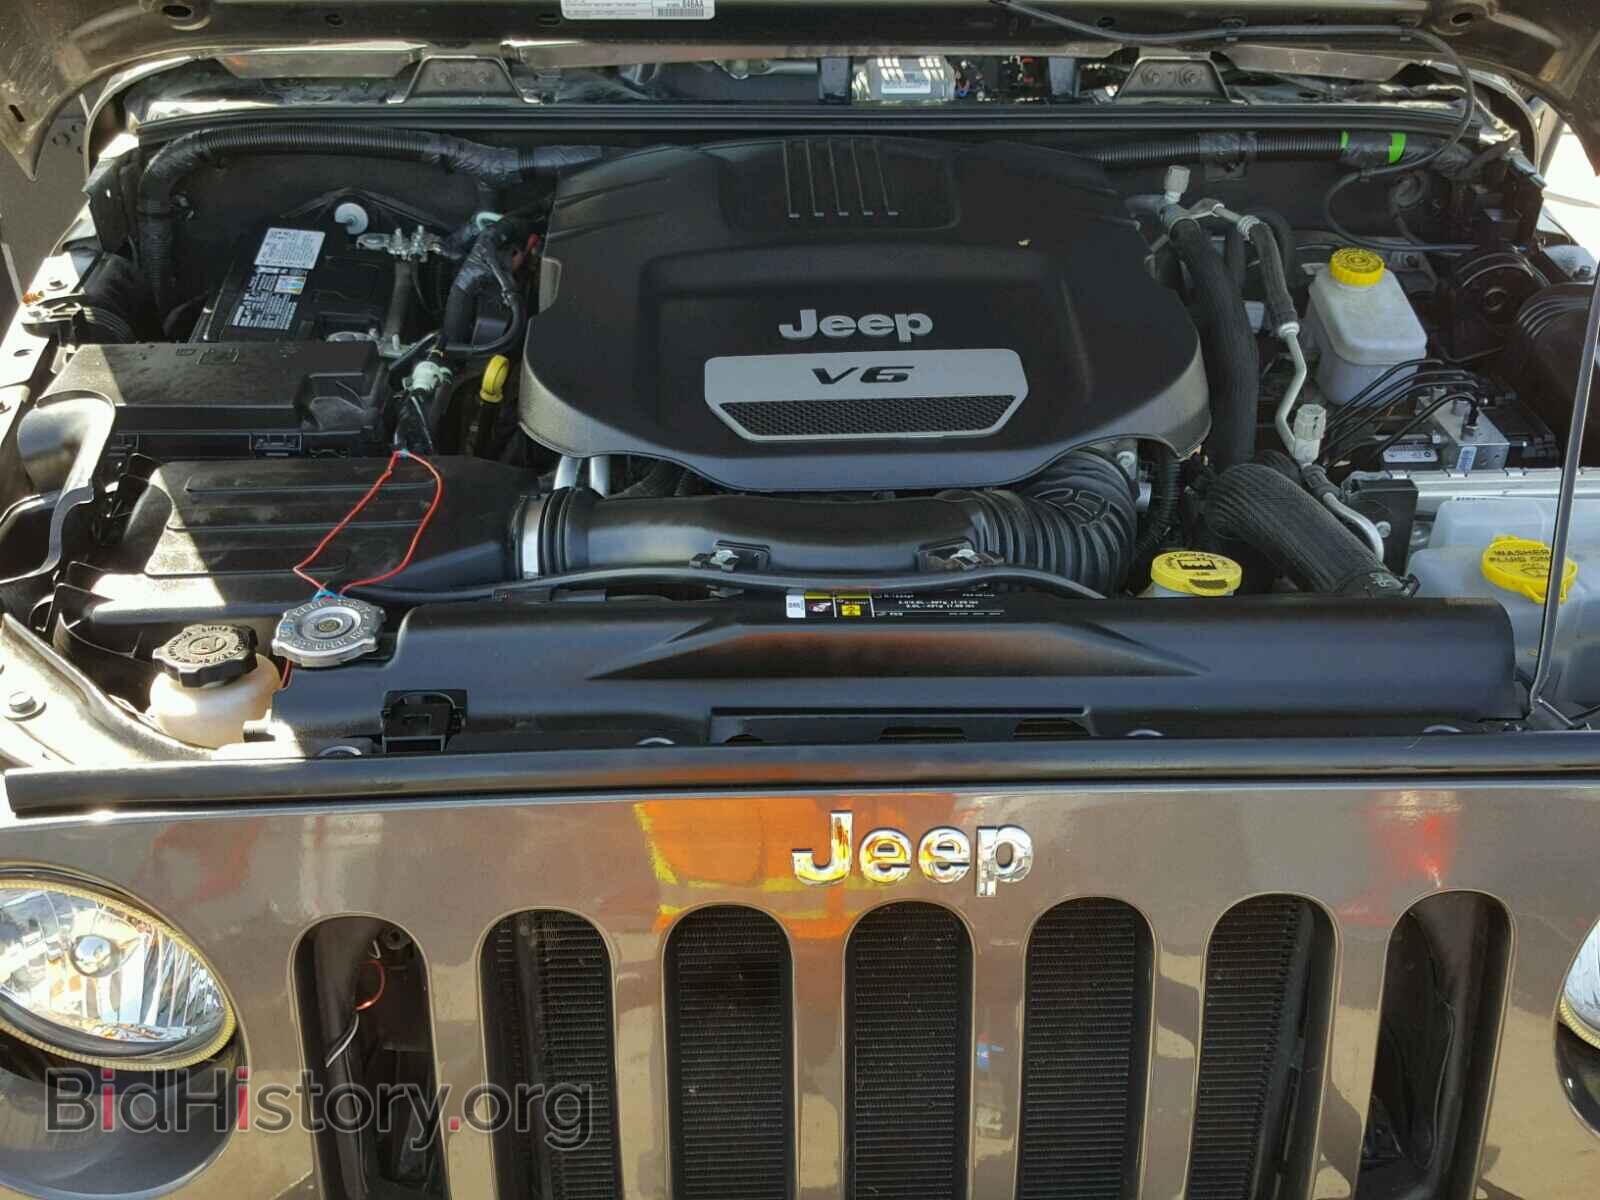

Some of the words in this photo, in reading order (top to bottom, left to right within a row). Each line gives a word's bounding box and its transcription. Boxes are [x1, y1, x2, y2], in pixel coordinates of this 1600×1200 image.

[778, 309, 934, 342] Jeep
[811, 366, 915, 385] V6
[792, 810, 1034, 897] Jeep
